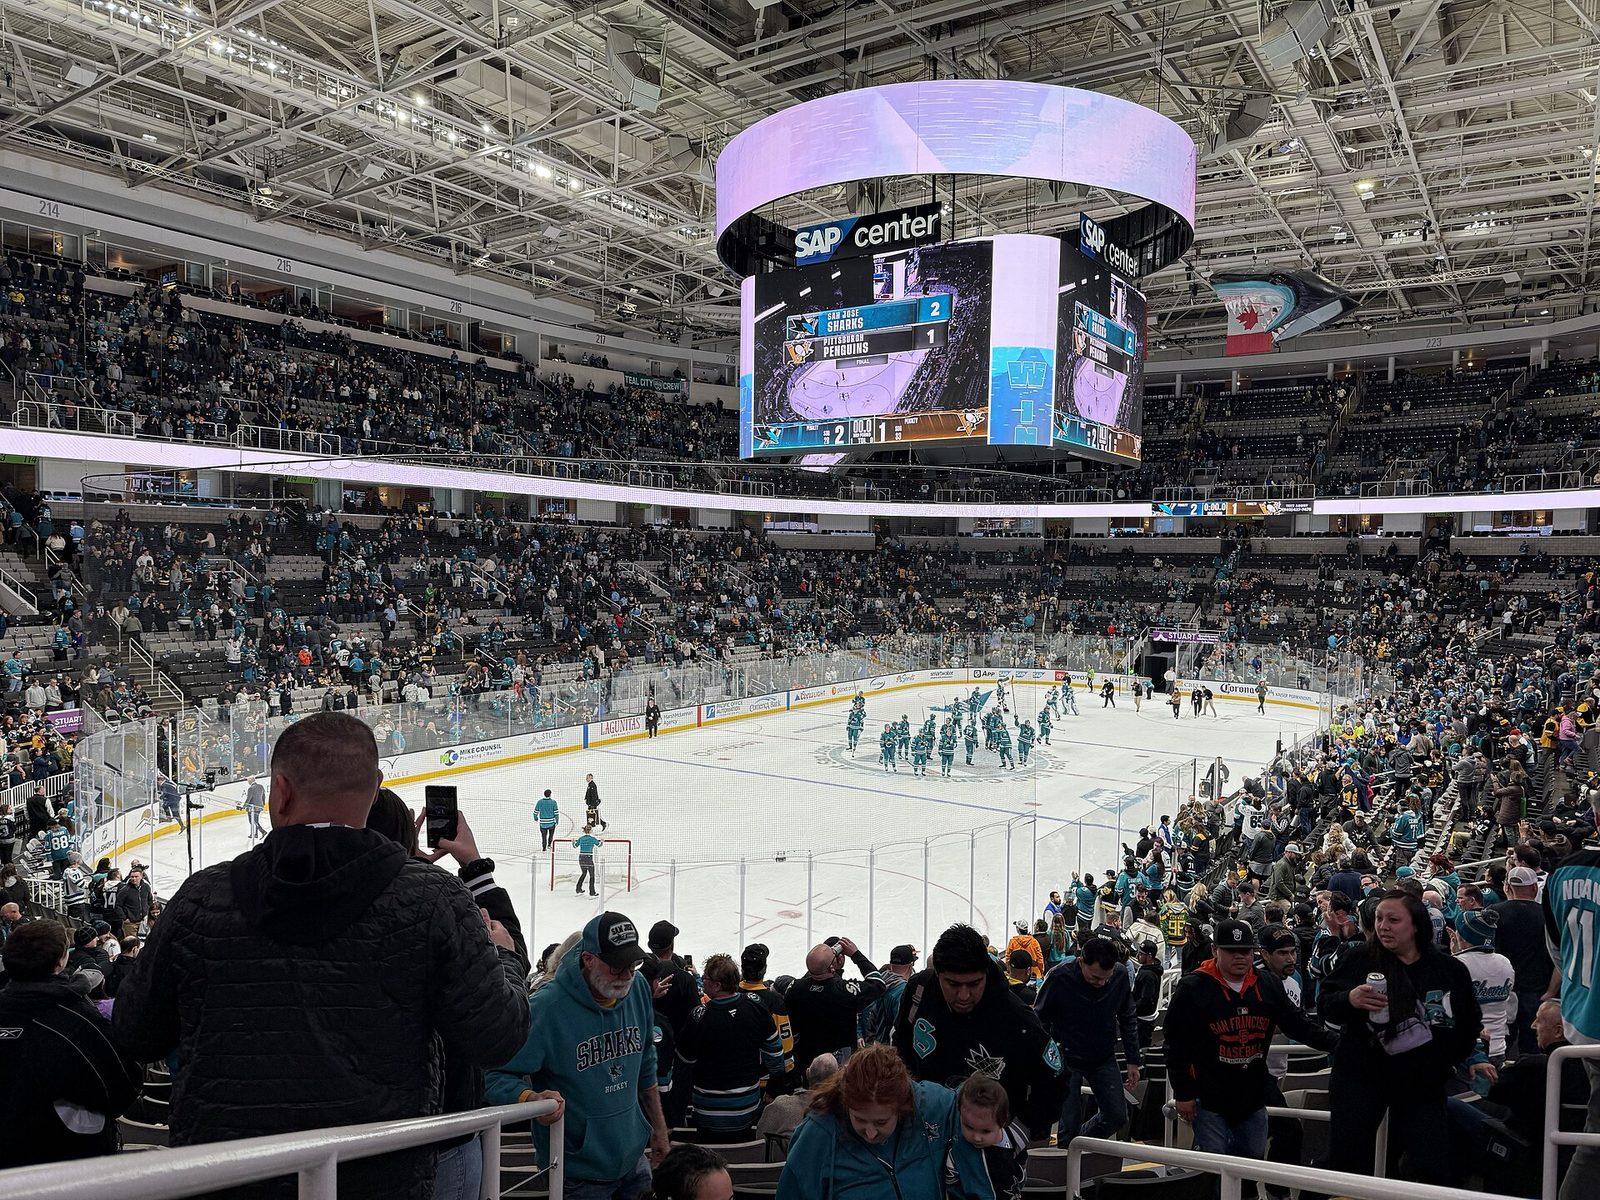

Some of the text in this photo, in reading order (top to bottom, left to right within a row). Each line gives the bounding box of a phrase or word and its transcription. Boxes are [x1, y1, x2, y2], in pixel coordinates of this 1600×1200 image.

[39, 200, 60, 218] 214
[795, 213, 939, 258] SAP center
[1084, 218, 1137, 278] SAP center
[276, 258, 292, 273] 215
[450, 301, 462, 314] 216
[827, 309, 860, 321] SAN JOSE
[930, 301, 941, 317] 2
[827, 317, 864, 333] SHARKS
[595, 334, 606, 345] 217
[823, 334, 865, 346] PITTSBURGH
[926, 329, 935, 344] 1
[1127, 336, 1132, 350] 2
[1426, 337, 1441, 349] 223
[823, 341, 869, 358] PENGUINS
[624, 375, 681, 391] TEAL CITY CREW
[853, 419, 872, 433] 00.0
[879, 422, 886, 443] 1
[834, 424, 845, 445] 2
[1091, 427, 1097, 448] 2
[23, 455, 37, 463] 114
[1190, 504, 1198, 515] 2
[1203, 503, 1226, 512] 0:00.0
[1232, 502, 1237, 515] 1
[1168, 631, 1197, 641] STUART
[1220, 683, 1256, 695] Corona
[54, 716, 83, 726] STUART
[600, 717, 641, 736] LAGUNITAS
[541, 730, 564, 740] STUART
[459, 744, 502, 756] MIKE COUNSIL
[51, 835, 69, 851] 88
[103, 892, 117, 909] 14
[1483, 939, 1492, 947] 19
[1567, 906, 1594, 989] 11
[780, 1022, 791, 1040] 5
[1209, 1019, 1229, 1035] SAN
[576, 1025, 643, 1073] SHARKS
[604, 1080, 629, 1094] HOCKEY
